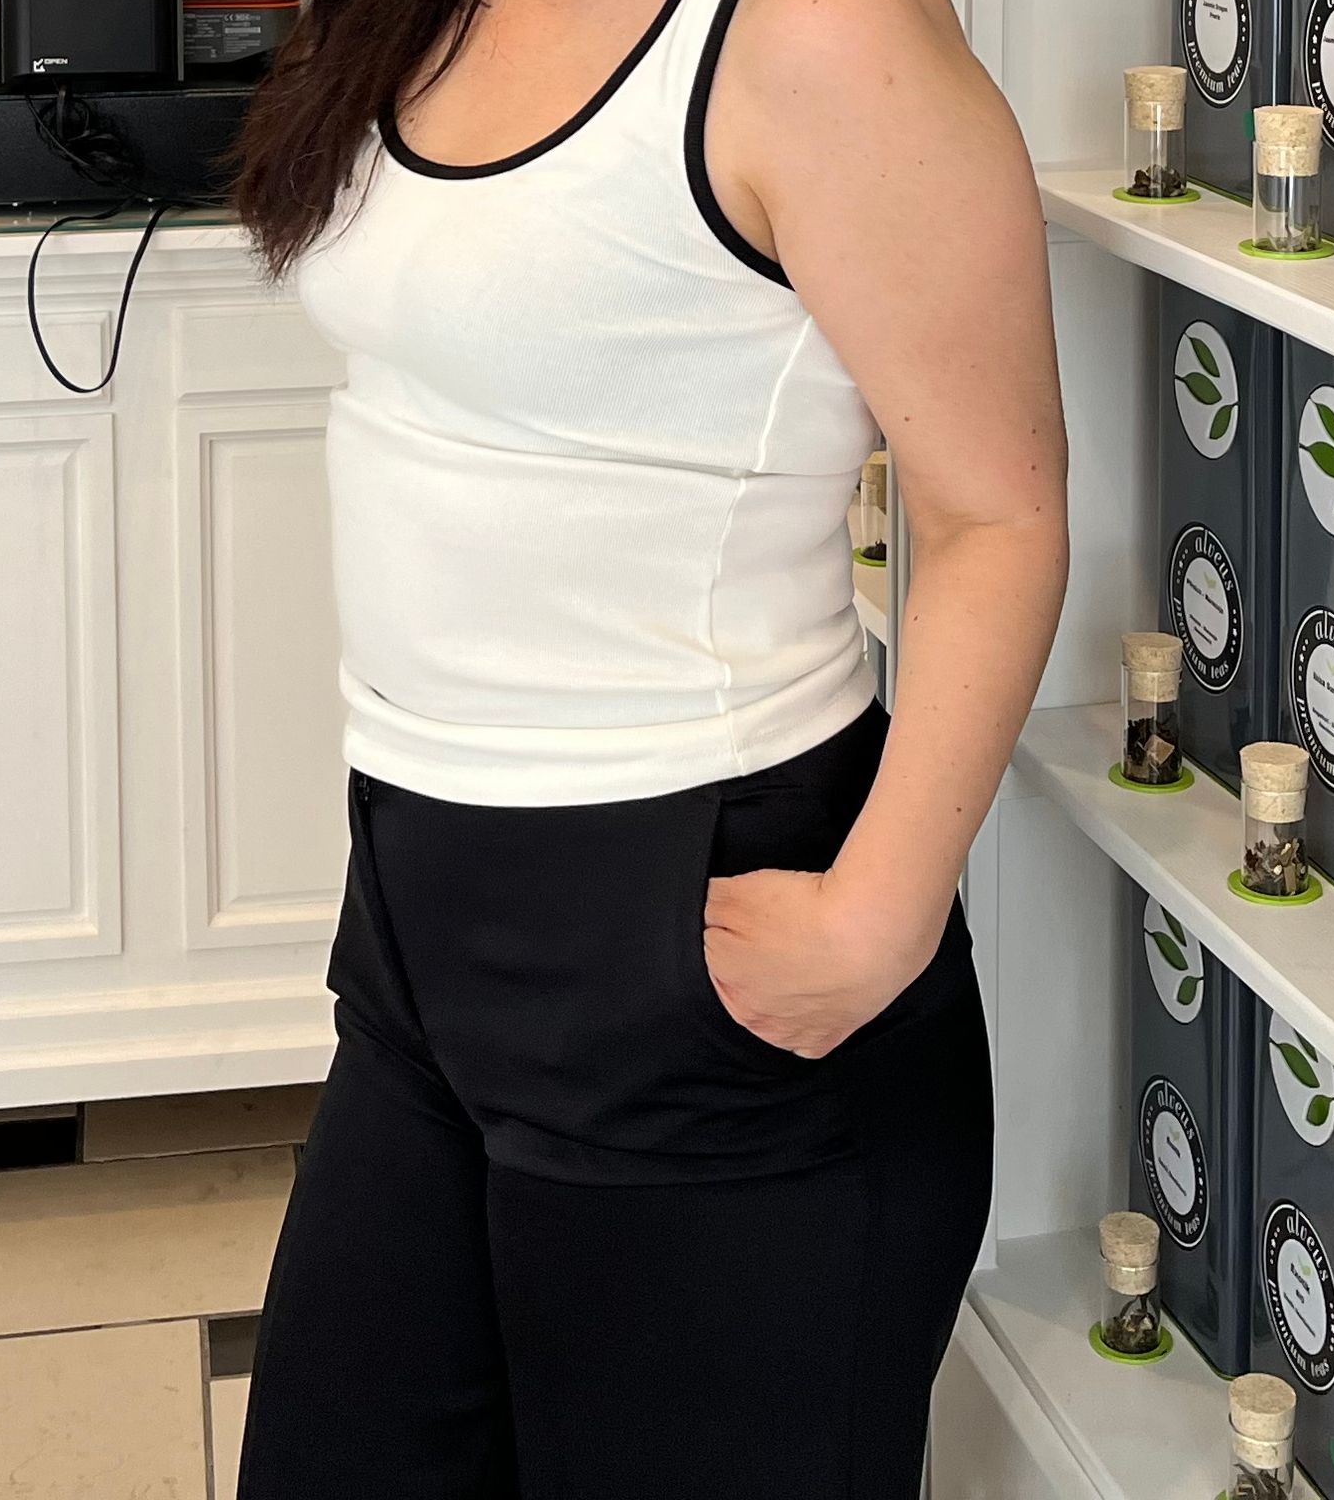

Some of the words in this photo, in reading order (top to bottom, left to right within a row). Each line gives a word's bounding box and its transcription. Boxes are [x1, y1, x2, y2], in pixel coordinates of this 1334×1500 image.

[1188, 40, 1224, 93] premium
[1227, 56, 1243, 88] teas
[1195, 530, 1234, 592] alveus
[1286, 1209, 1329, 1282] alveus
